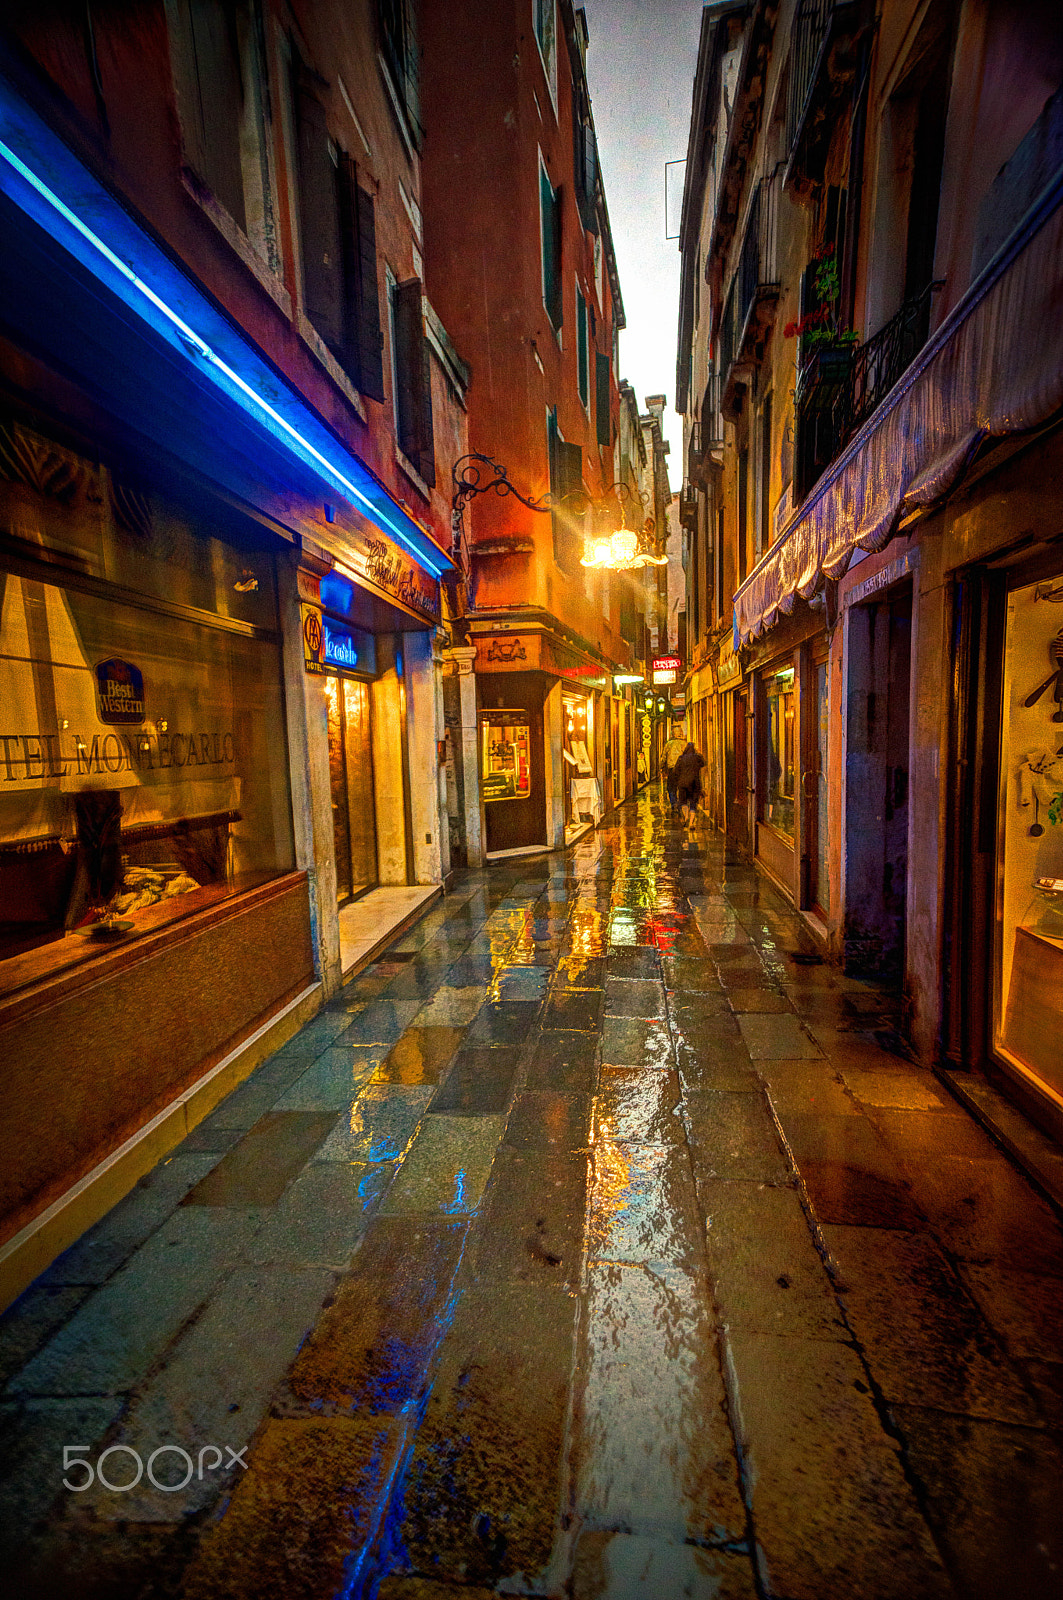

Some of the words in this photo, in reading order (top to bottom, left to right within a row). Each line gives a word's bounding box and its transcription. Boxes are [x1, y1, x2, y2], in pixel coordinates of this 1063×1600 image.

[306, 661, 323, 673] HOTEL
[107, 679, 132, 697] Best
[100, 694, 143, 713] Western
[72, 732, 236, 776] MONTECARLO
